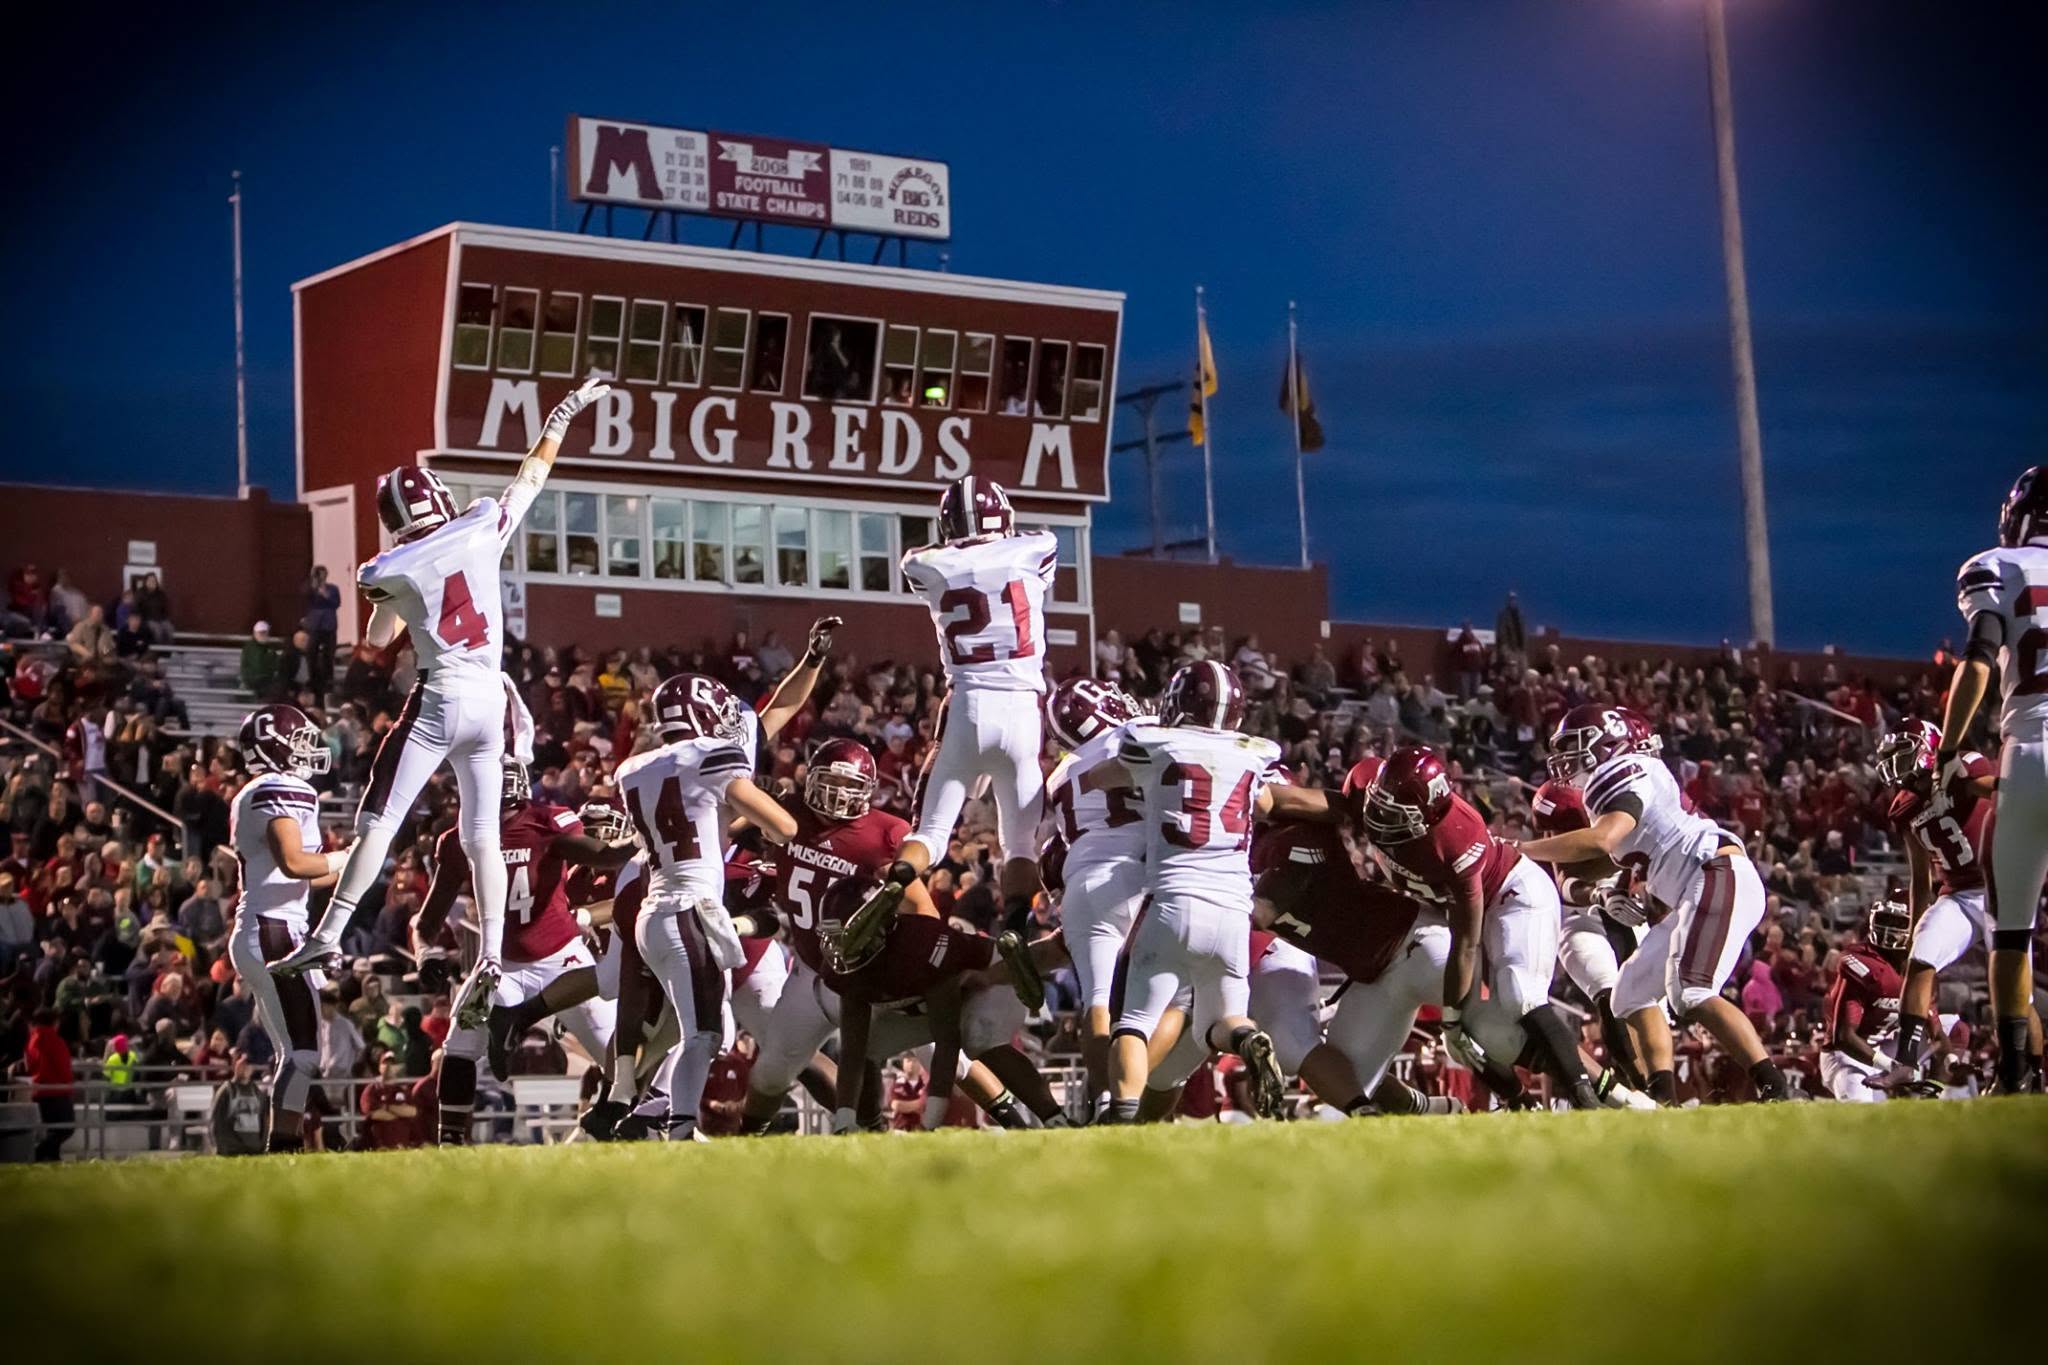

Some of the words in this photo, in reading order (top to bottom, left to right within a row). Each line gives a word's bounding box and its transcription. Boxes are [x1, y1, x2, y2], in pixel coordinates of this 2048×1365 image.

[586, 126, 663, 200] M
[751, 157, 789, 175] 2008
[837, 173, 848, 186] 71
[735, 175, 807, 198] FOOTBALL
[888, 167, 944, 206] MUSKEGON
[902, 189, 930, 207] BIG
[716, 191, 760, 211] STATE
[766, 197, 825, 219] CHAMPS
[893, 208, 940, 229] REDS
[477, 378, 542, 448] M
[589, 388, 738, 464] BIG
[767, 401, 971, 480] REDS
[1020, 423, 1078, 489] M
[437, 570, 490, 651] 4
[940, 578, 1035, 666] 21
[626, 776, 703, 870] 14
[1160, 762, 1255, 852] 34
[787, 842, 859, 876] MUSKEGON
